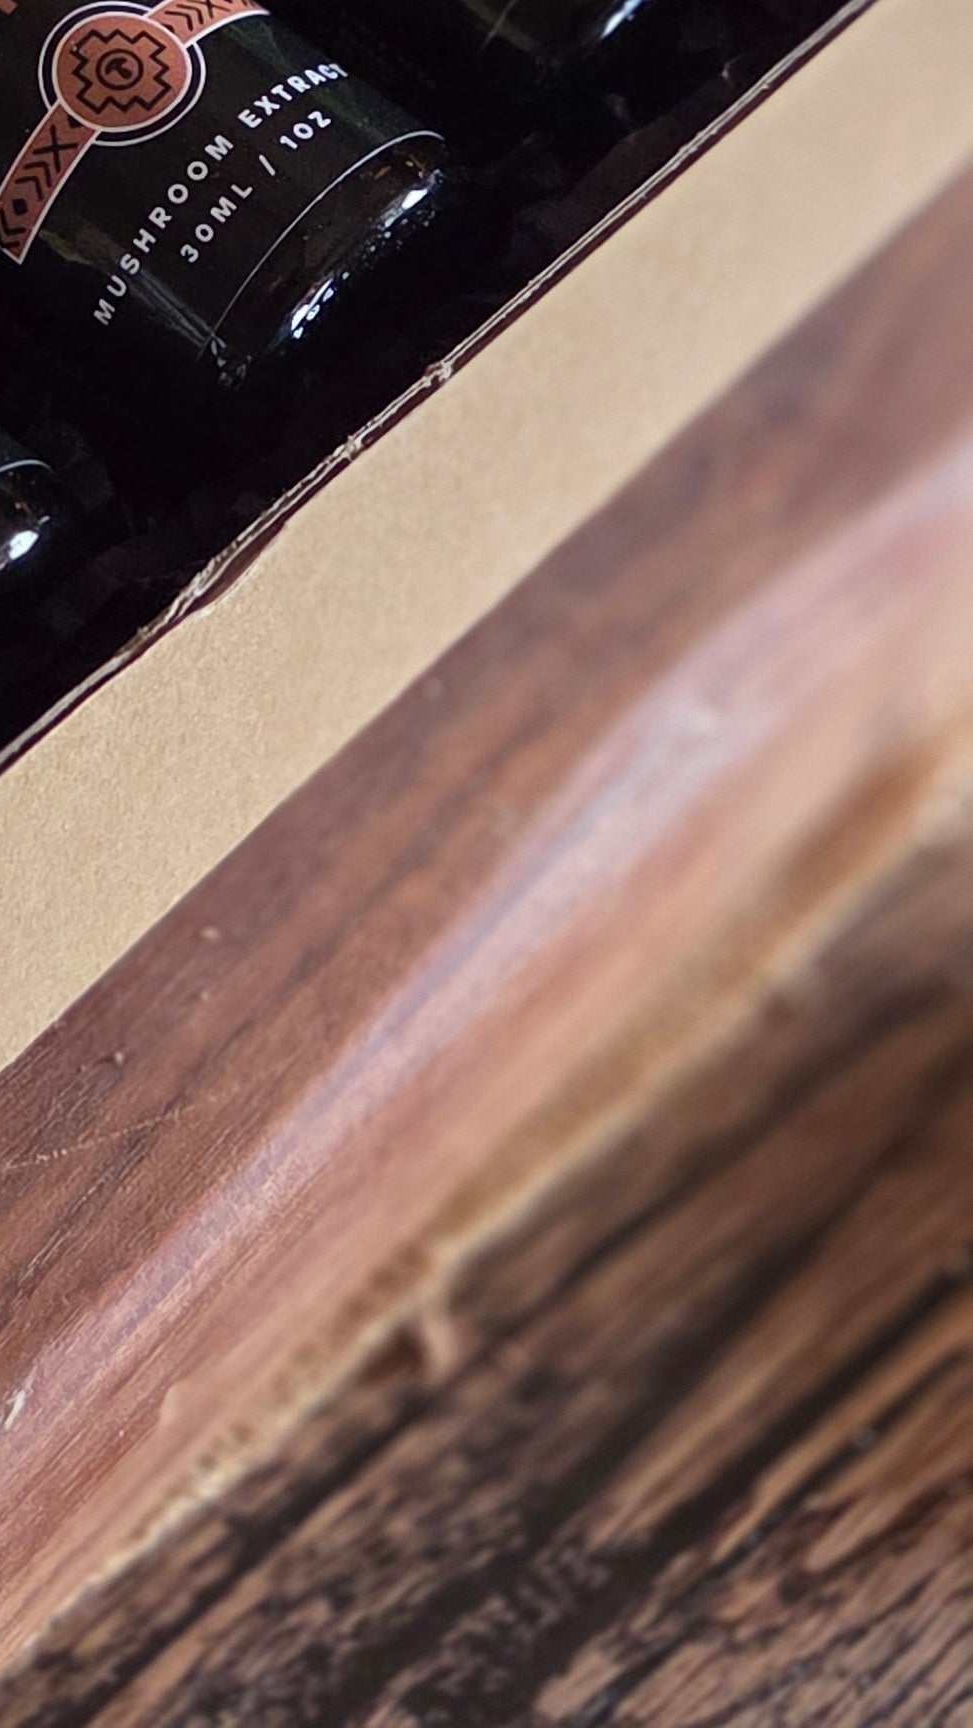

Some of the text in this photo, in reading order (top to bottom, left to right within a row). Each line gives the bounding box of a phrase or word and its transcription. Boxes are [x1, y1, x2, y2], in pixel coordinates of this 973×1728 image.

[93, 62, 349, 326] MUSHROOM EXTRACT
[180, 109, 332, 264] 30ML / 1OZ
